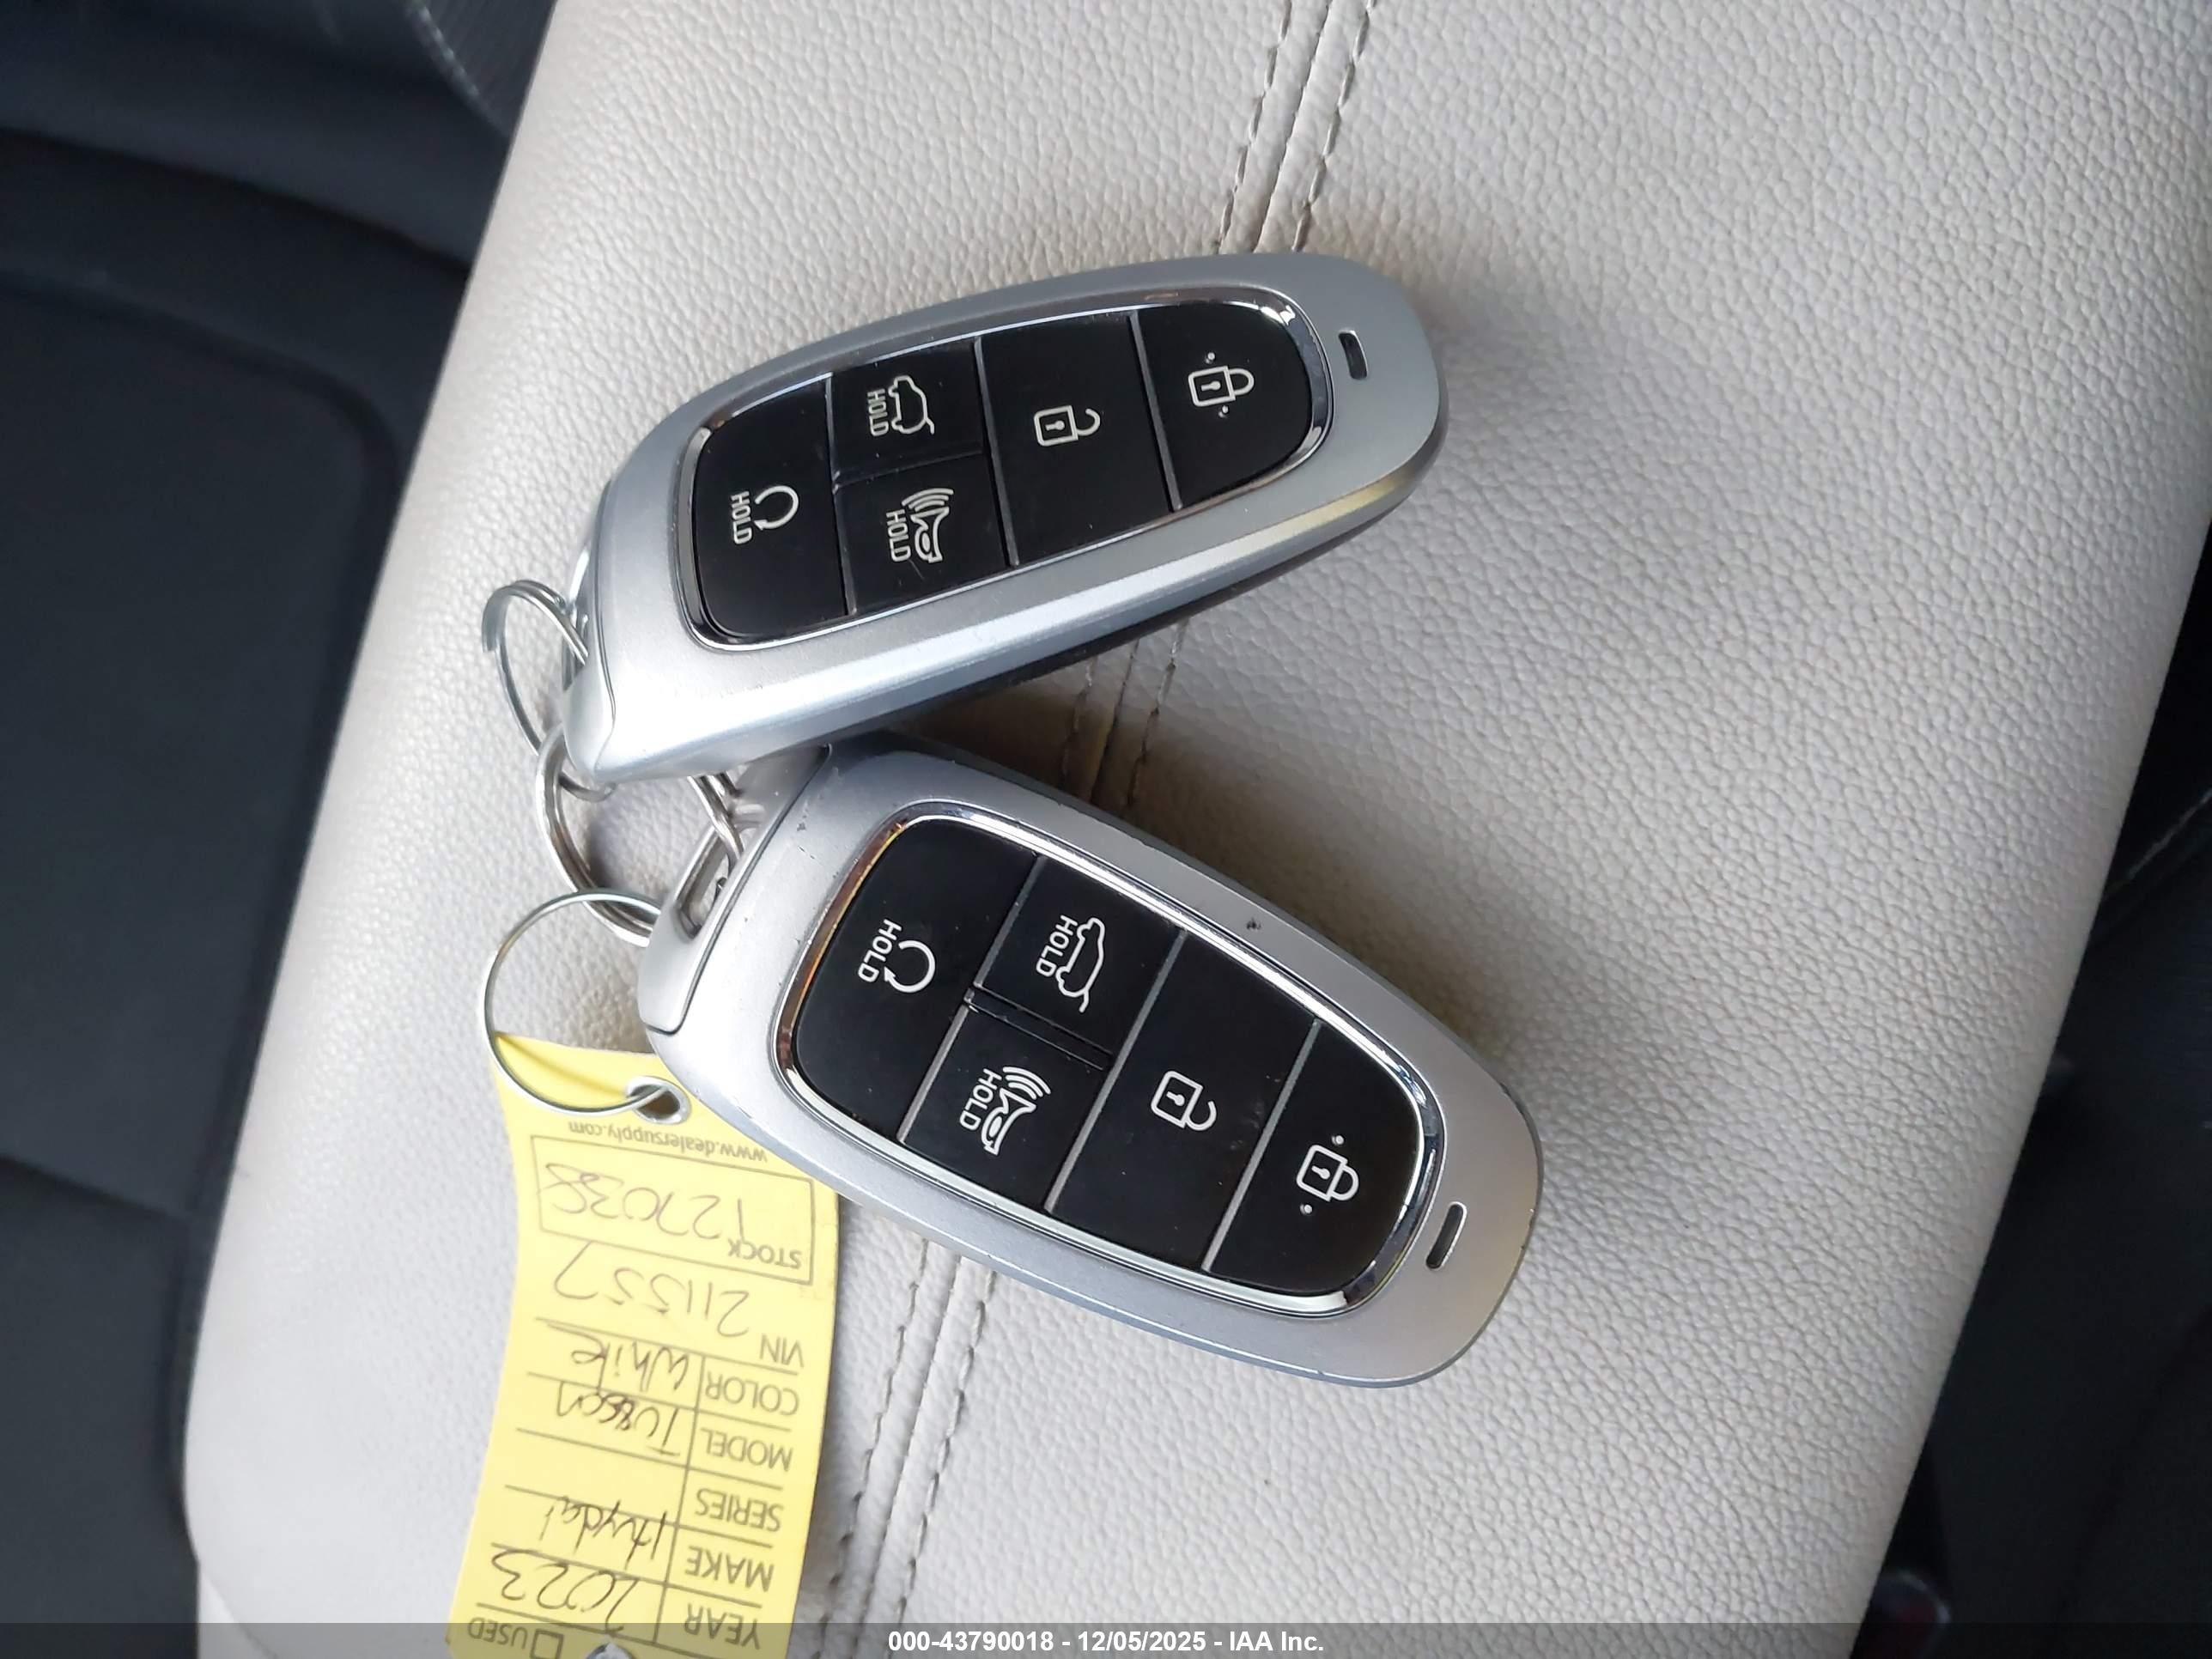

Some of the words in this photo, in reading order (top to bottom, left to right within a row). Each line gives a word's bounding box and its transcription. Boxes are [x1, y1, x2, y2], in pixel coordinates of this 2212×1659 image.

[867, 388, 890, 436] HOLD
[731, 491, 753, 544] HOLD
[886, 509, 912, 562] HOLD
[858, 919, 902, 982] HOLD
[1036, 915, 1078, 977] HOLD
[959, 1068, 1003, 1131] HOLD
[568, 1121, 768, 1163] www.dealersupply.com
[728, 1239, 802, 1268] STOCK
[761, 1334, 804, 1367] VIN
[705, 1372, 799, 1416] COLOR
[701, 1427, 793, 1472] MODEL
[696, 1488, 784, 1532] SERIES
[491, 1548, 641, 1634] 2023
[685, 1546, 775, 1592] MAKE
[467, 1617, 528, 1650] USED
[684, 1604, 761, 1650] YEAR
